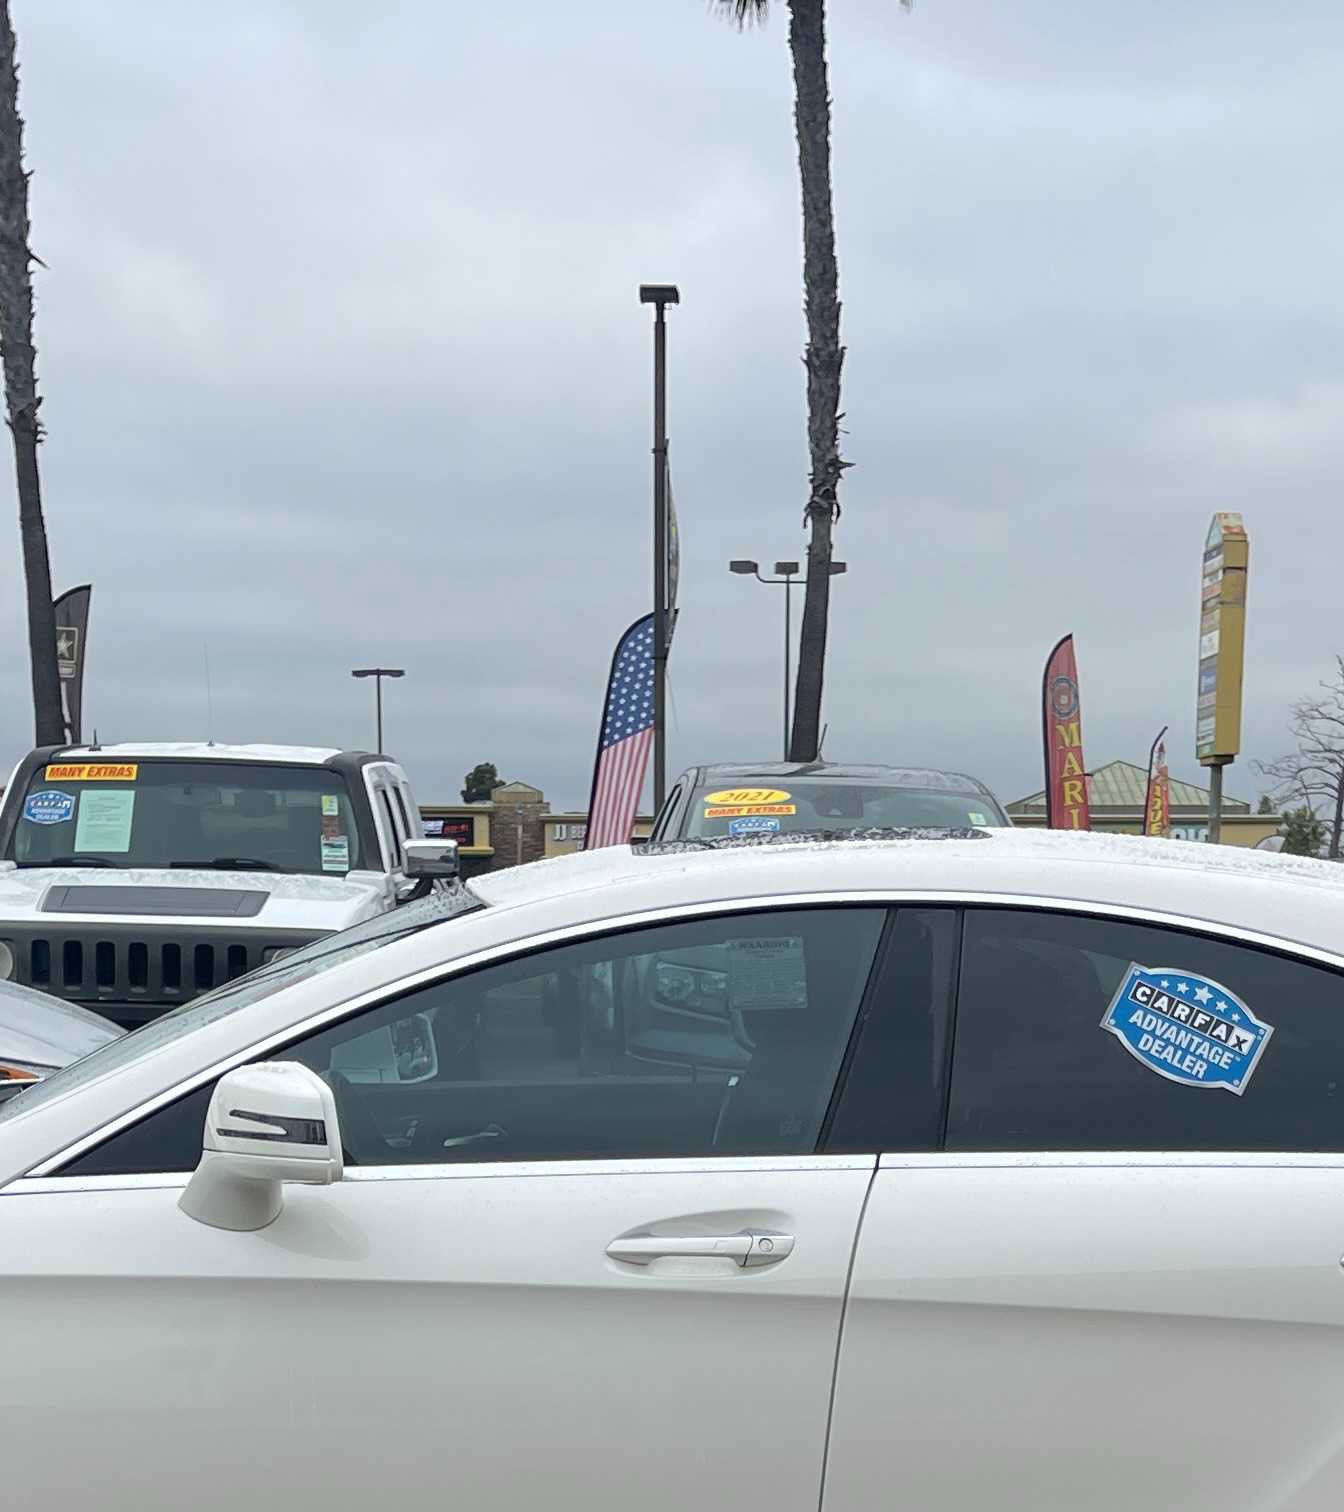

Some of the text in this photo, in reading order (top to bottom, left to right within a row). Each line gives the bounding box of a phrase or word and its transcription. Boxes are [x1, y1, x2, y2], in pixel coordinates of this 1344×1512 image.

[48, 766, 134, 778] MANY EXTRAS
[707, 806, 793, 816] MANY EXTRAS
[719, 791, 776, 803] 2021
[1132, 983, 1252, 1055] CARFAX
[1127, 1009, 1235, 1070] ADVANTAGE
[1137, 1032, 1208, 1080] DEALER
